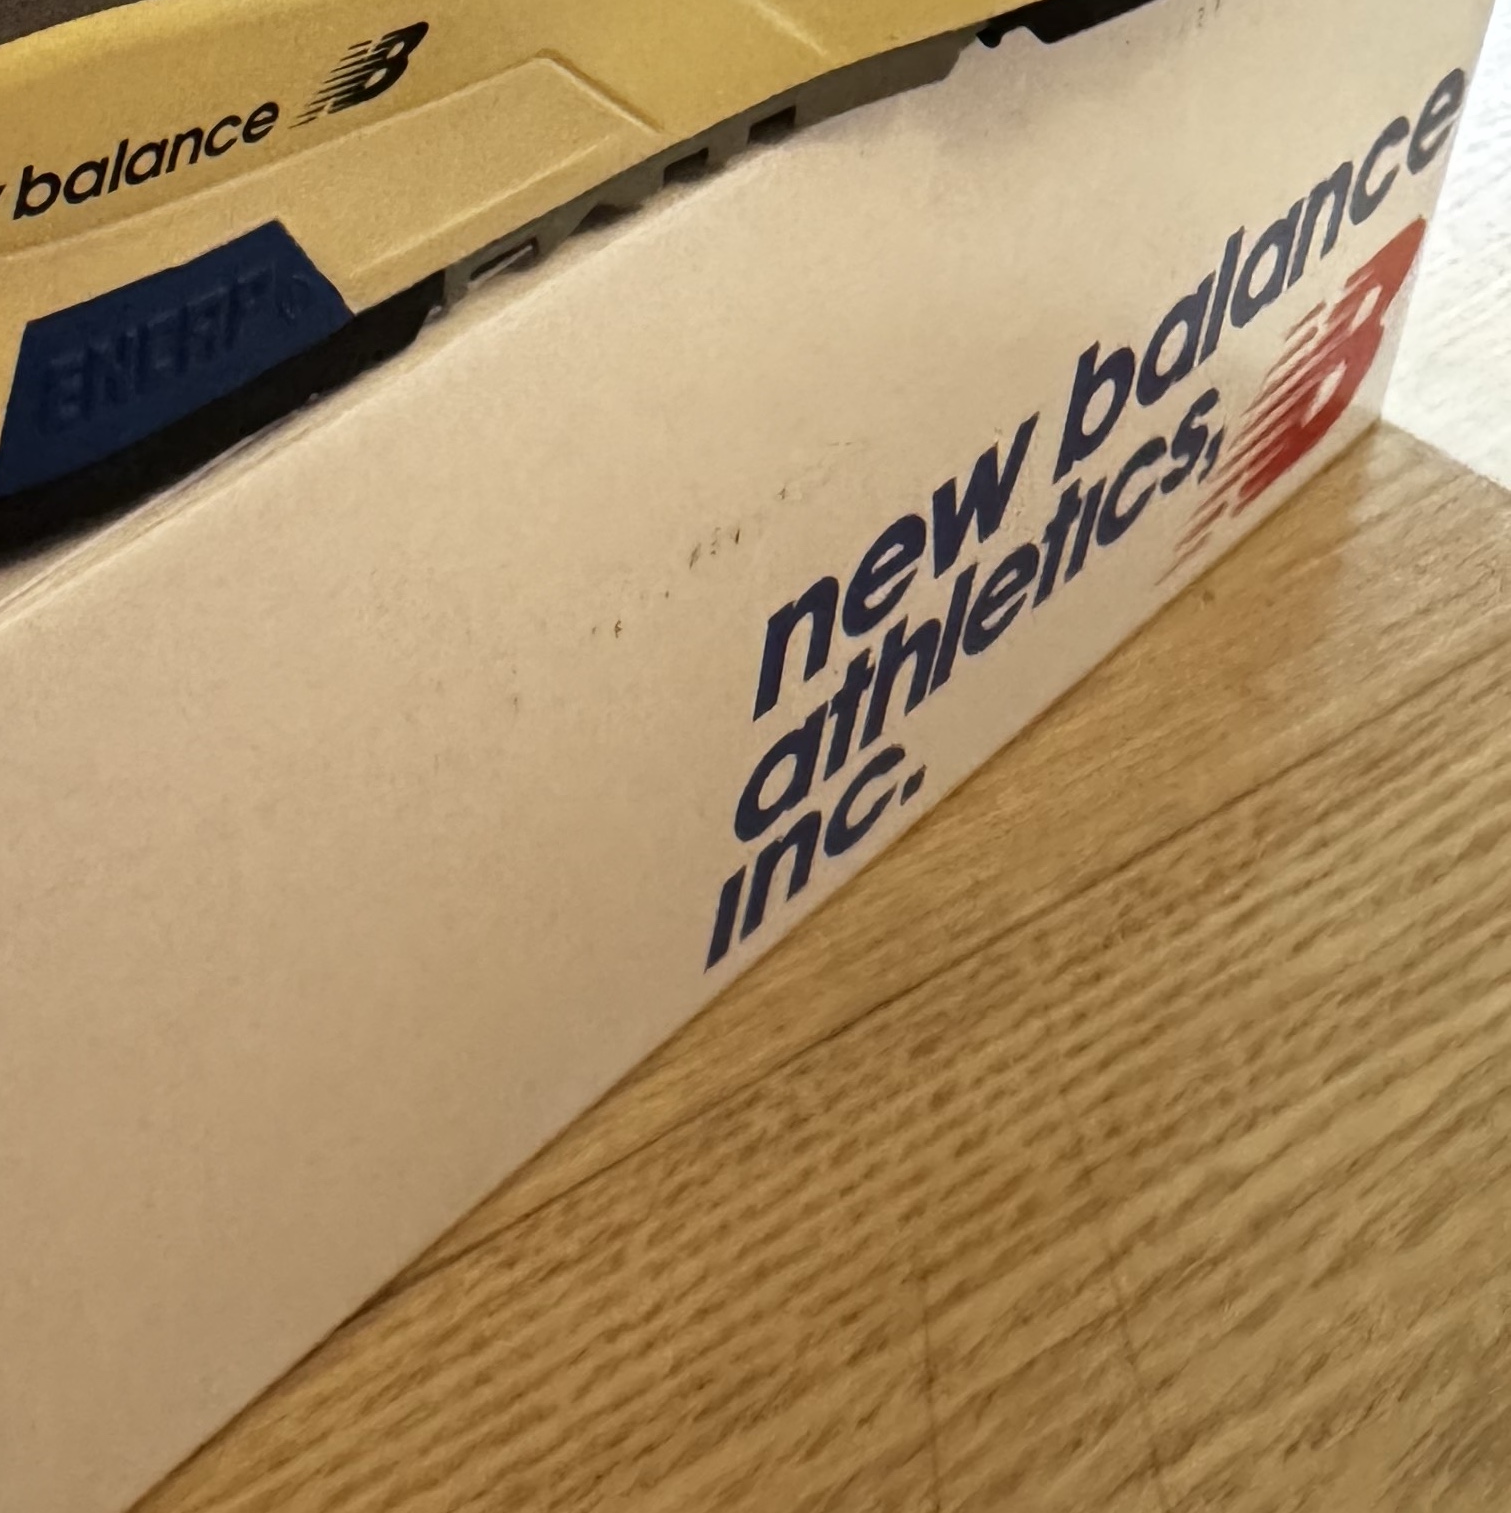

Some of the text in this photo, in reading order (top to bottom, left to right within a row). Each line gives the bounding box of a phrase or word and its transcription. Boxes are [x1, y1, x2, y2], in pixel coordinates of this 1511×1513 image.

[13, 101, 280, 221] balance
[752, 66, 1467, 721] new balance
[734, 387, 1226, 842] athletics,
[703, 743, 928, 974] inc.
